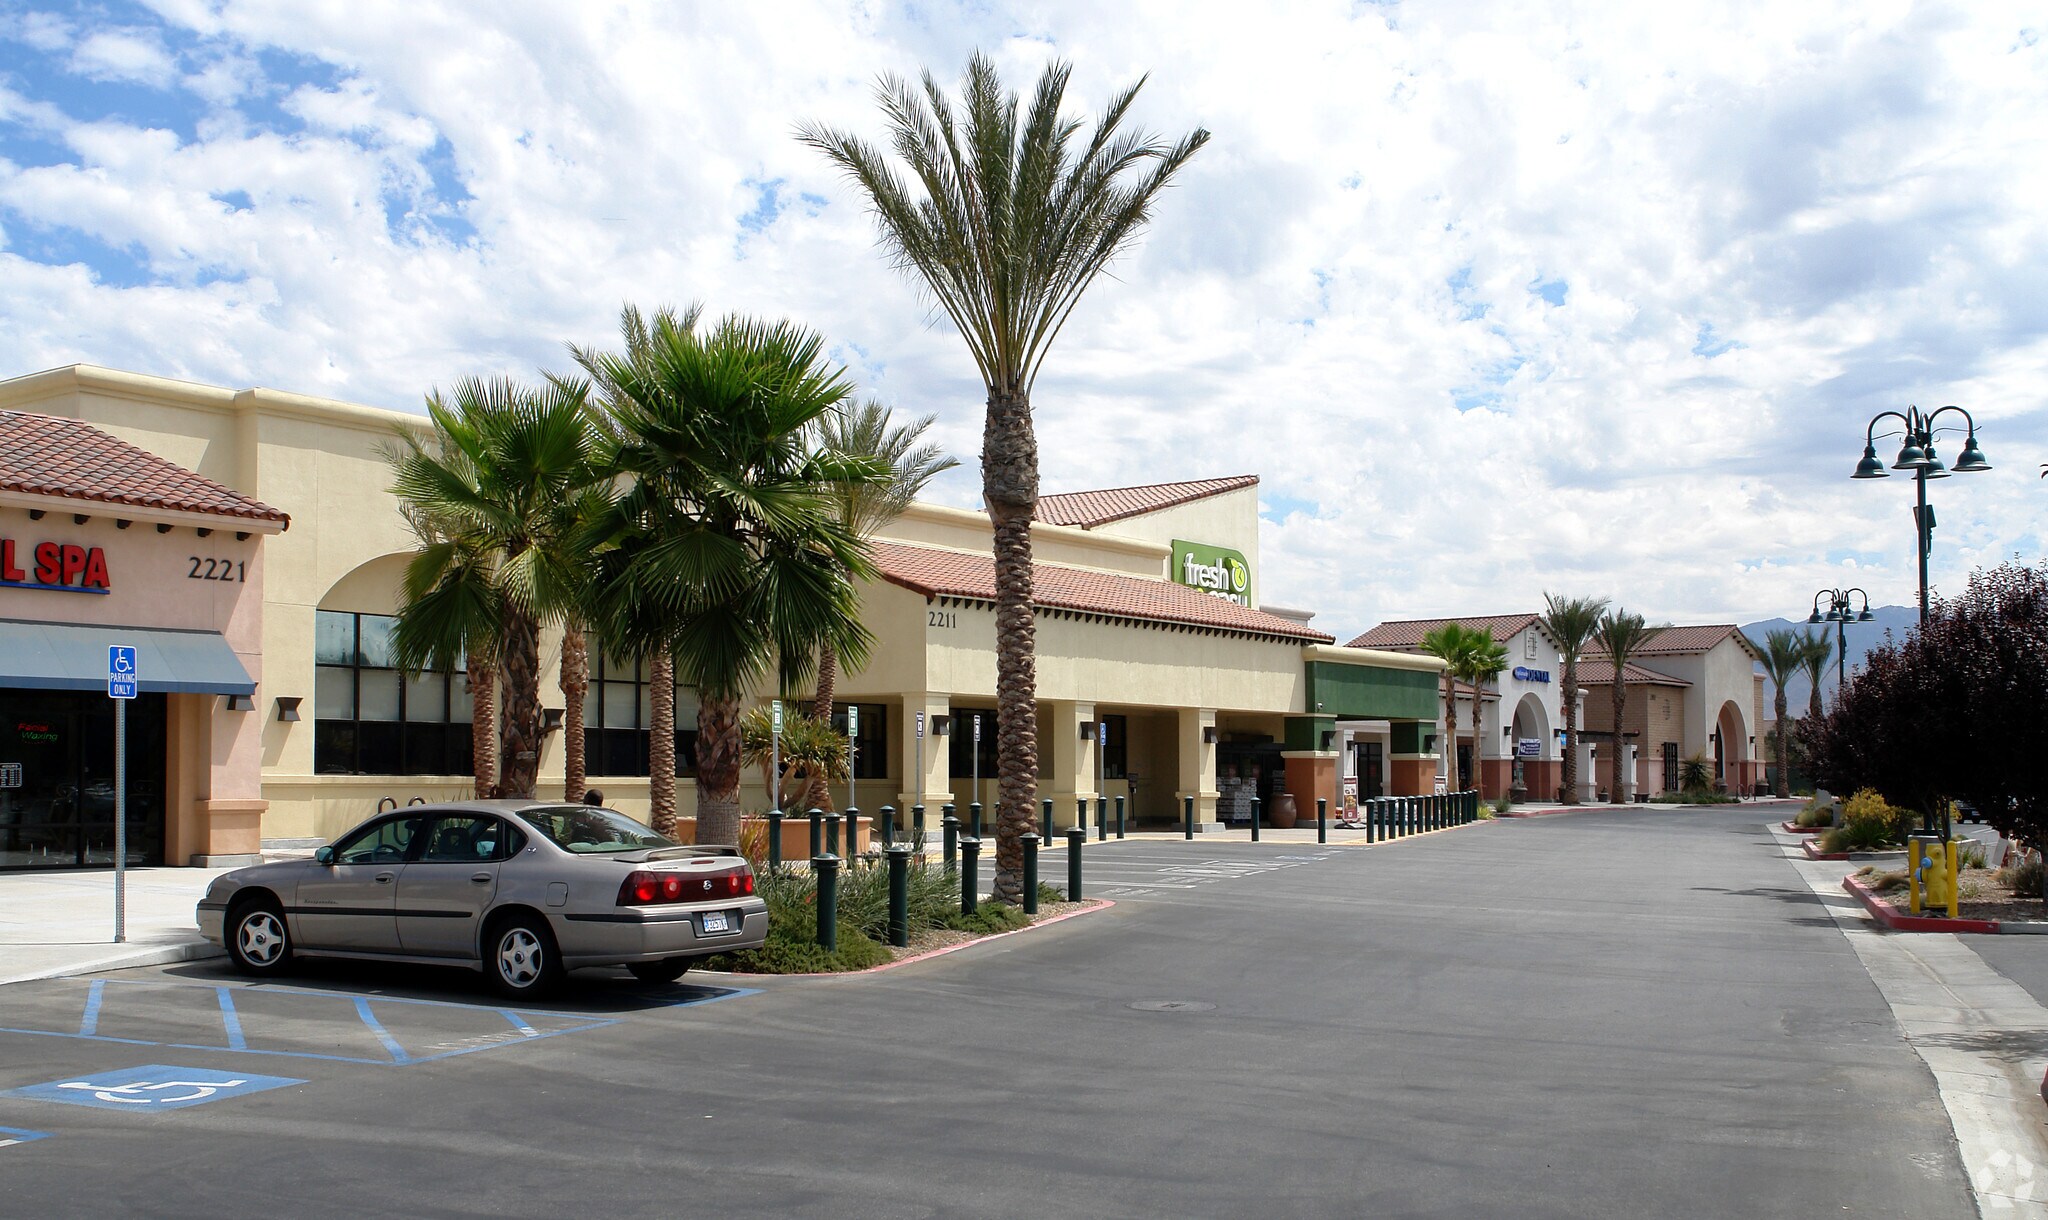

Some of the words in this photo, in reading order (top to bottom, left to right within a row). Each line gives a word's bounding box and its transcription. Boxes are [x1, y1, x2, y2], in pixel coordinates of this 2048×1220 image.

[0, 538, 25, 581] L
[34, 541, 110, 588] SPA
[188, 556, 246, 582] 2221
[1183, 552, 1230, 590] fresh
[928, 611, 956, 628] 2211
[110, 672, 135, 684] PARKING
[1527, 669, 1551, 683] DENTAL
[114, 684, 131, 695] ONLY
[21, 731, 58, 743] Waxing
